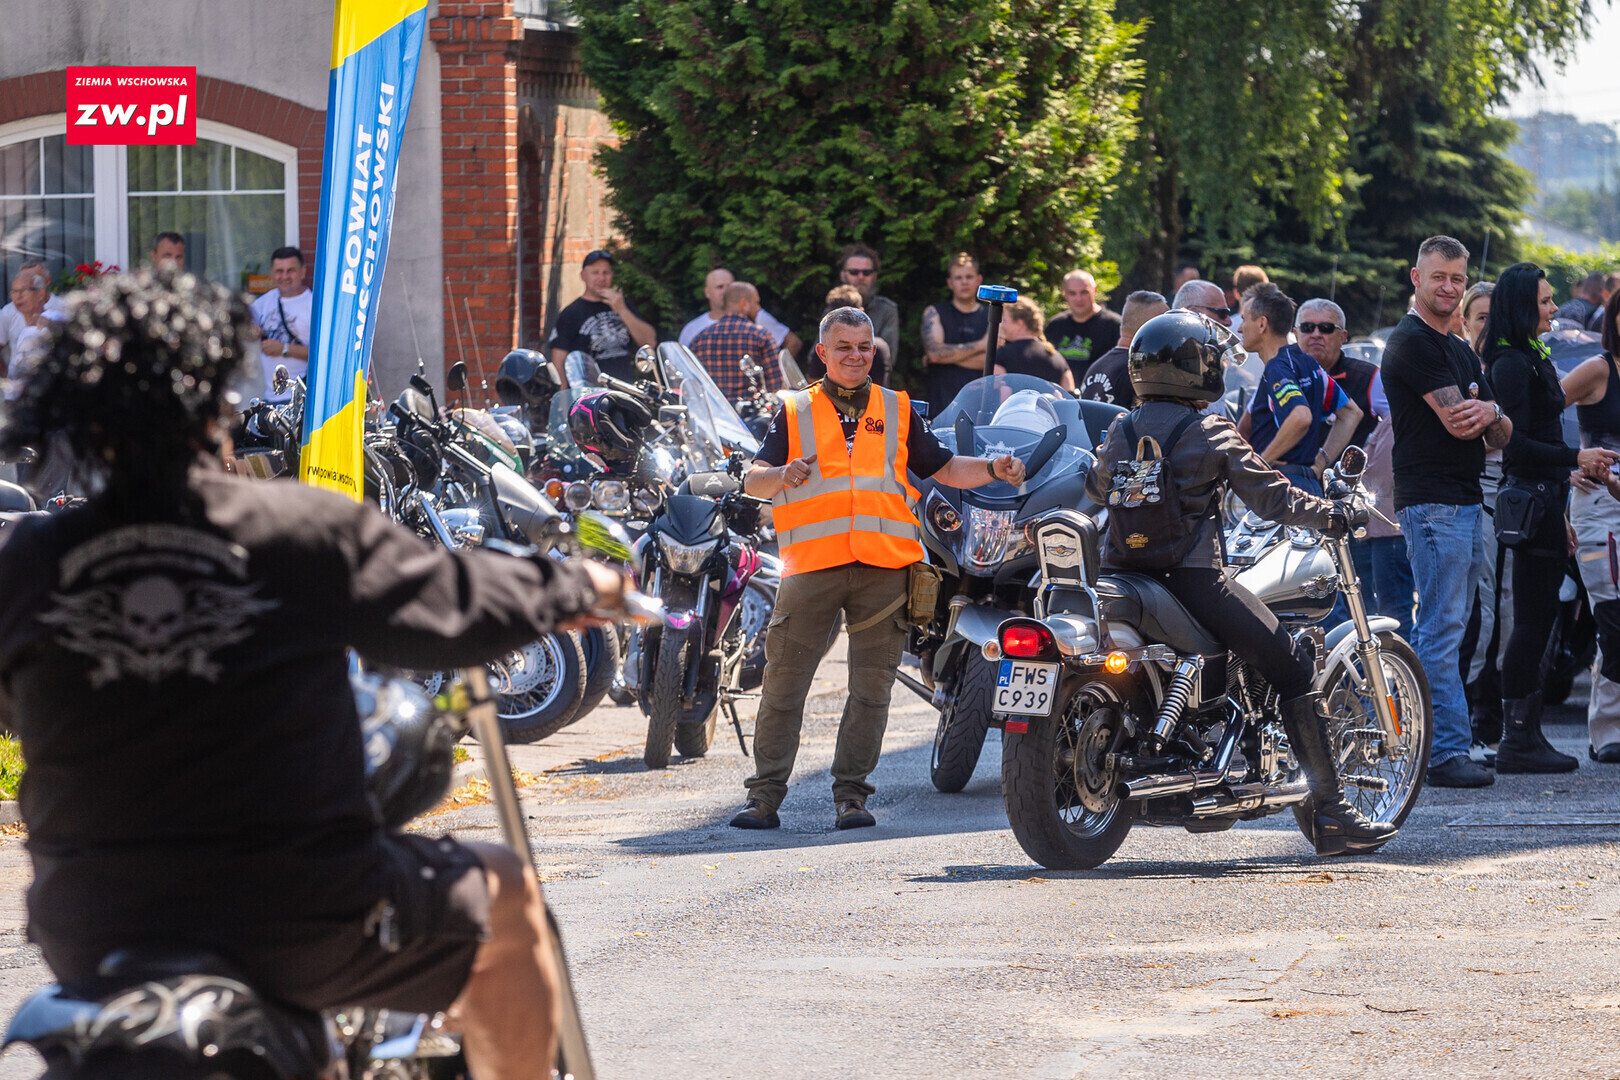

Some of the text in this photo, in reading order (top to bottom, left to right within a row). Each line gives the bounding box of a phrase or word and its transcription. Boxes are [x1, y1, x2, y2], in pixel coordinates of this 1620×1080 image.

[341, 123, 373, 295] POWIAT
[354, 81, 395, 351] WSCHOWSKI
[998, 676, 1009, 685] PL
[1011, 666, 1048, 685] FWS
[998, 689, 1048, 709] C939
